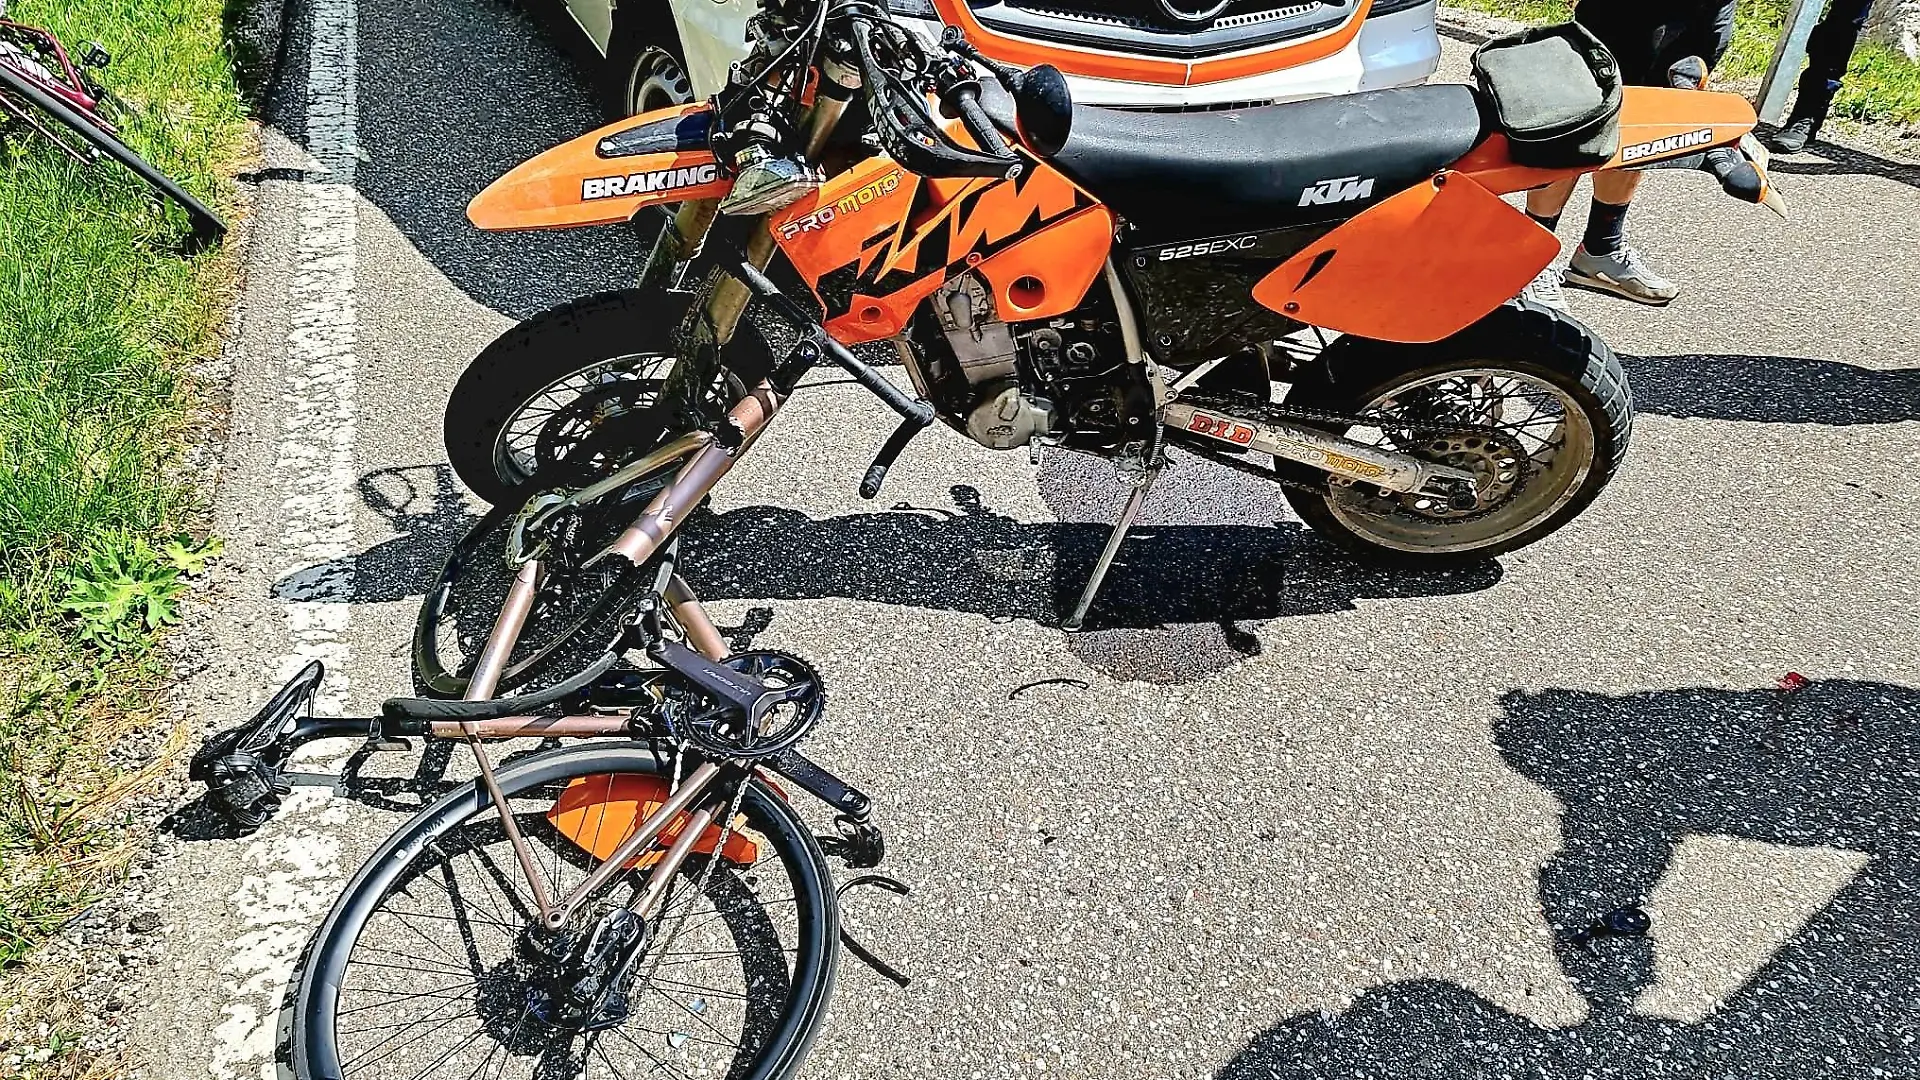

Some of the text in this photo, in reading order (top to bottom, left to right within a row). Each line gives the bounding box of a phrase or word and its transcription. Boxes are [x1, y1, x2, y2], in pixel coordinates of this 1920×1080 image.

[1622, 130, 1712, 162] BRAKING
[582, 164, 717, 200] BRAKING
[1298, 175, 1375, 207] KTM
